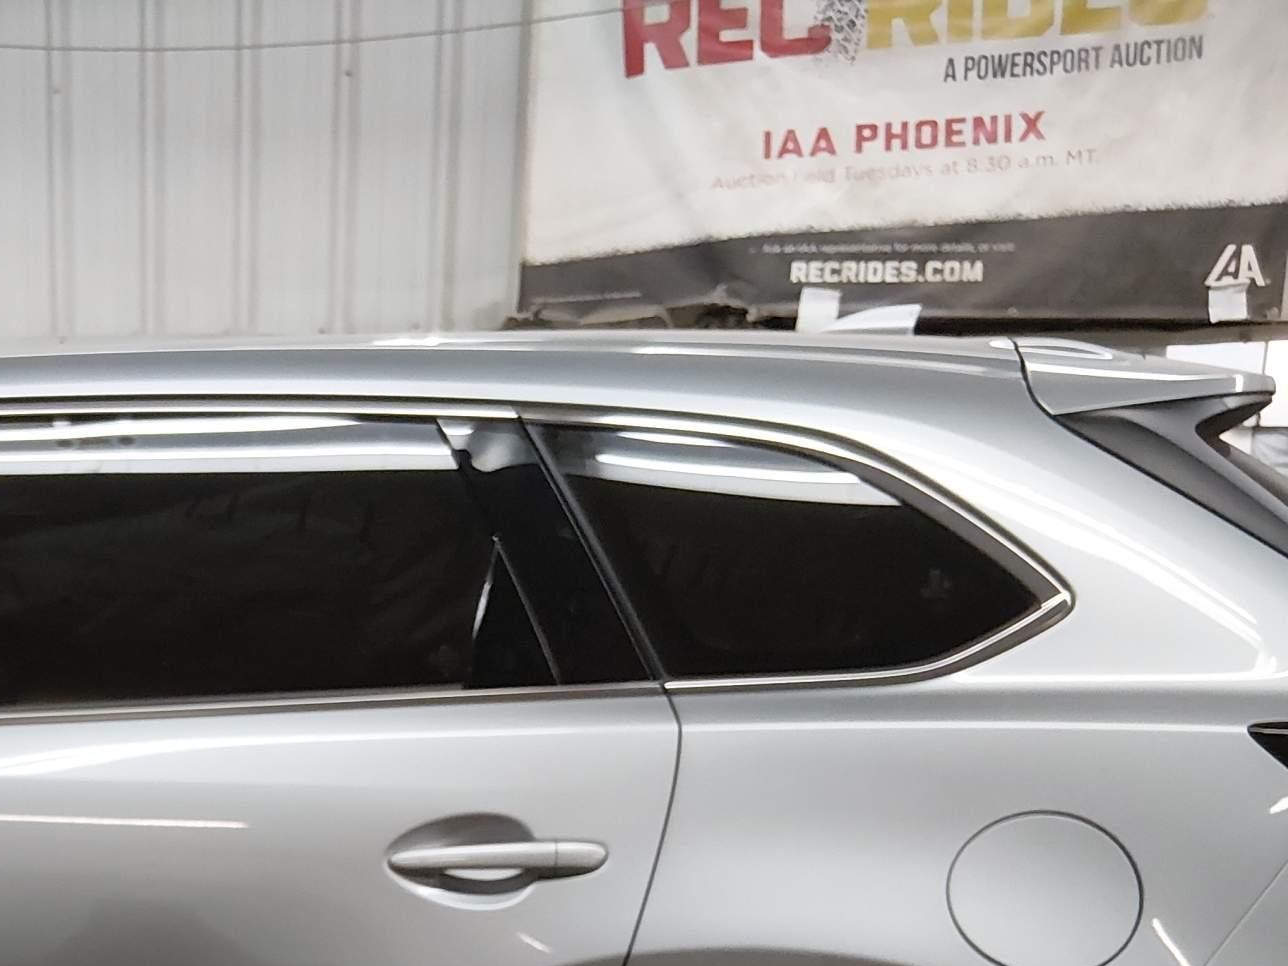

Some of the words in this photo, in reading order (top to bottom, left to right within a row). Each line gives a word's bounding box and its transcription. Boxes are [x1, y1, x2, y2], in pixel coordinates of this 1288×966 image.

[623, 0, 832, 78] REC
[943, 57, 957, 82] A
[963, 46, 1105, 81] POWERSPORT
[1109, 35, 1204, 69] AUCTION
[763, 126, 838, 160] IAA
[854, 110, 1047, 154] PHOENIX
[790, 259, 984, 284] RECRIDES.COM
